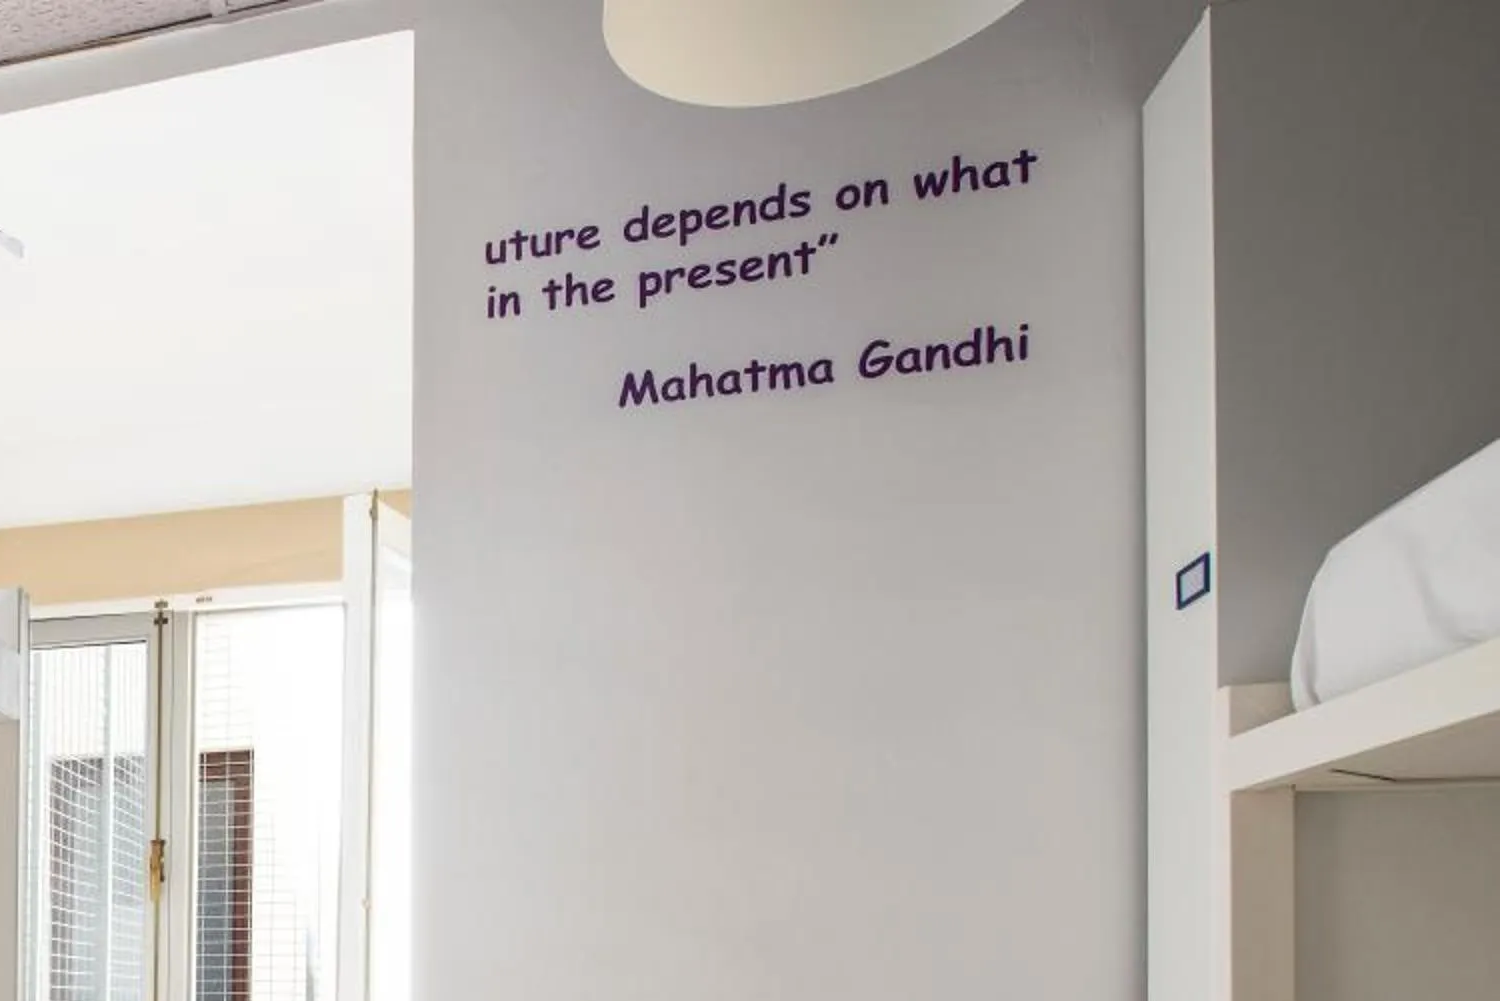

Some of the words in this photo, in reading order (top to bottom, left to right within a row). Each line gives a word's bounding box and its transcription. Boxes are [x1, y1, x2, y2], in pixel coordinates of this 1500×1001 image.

[484, 224, 601, 265] uture
[623, 182, 812, 246] depends
[835, 177, 890, 212] on
[913, 148, 1038, 200] what
[487, 286, 521, 319] in
[541, 272, 616, 312] the
[618, 358, 836, 408] Mahatma
[858, 323, 1030, 380] Gandhi
